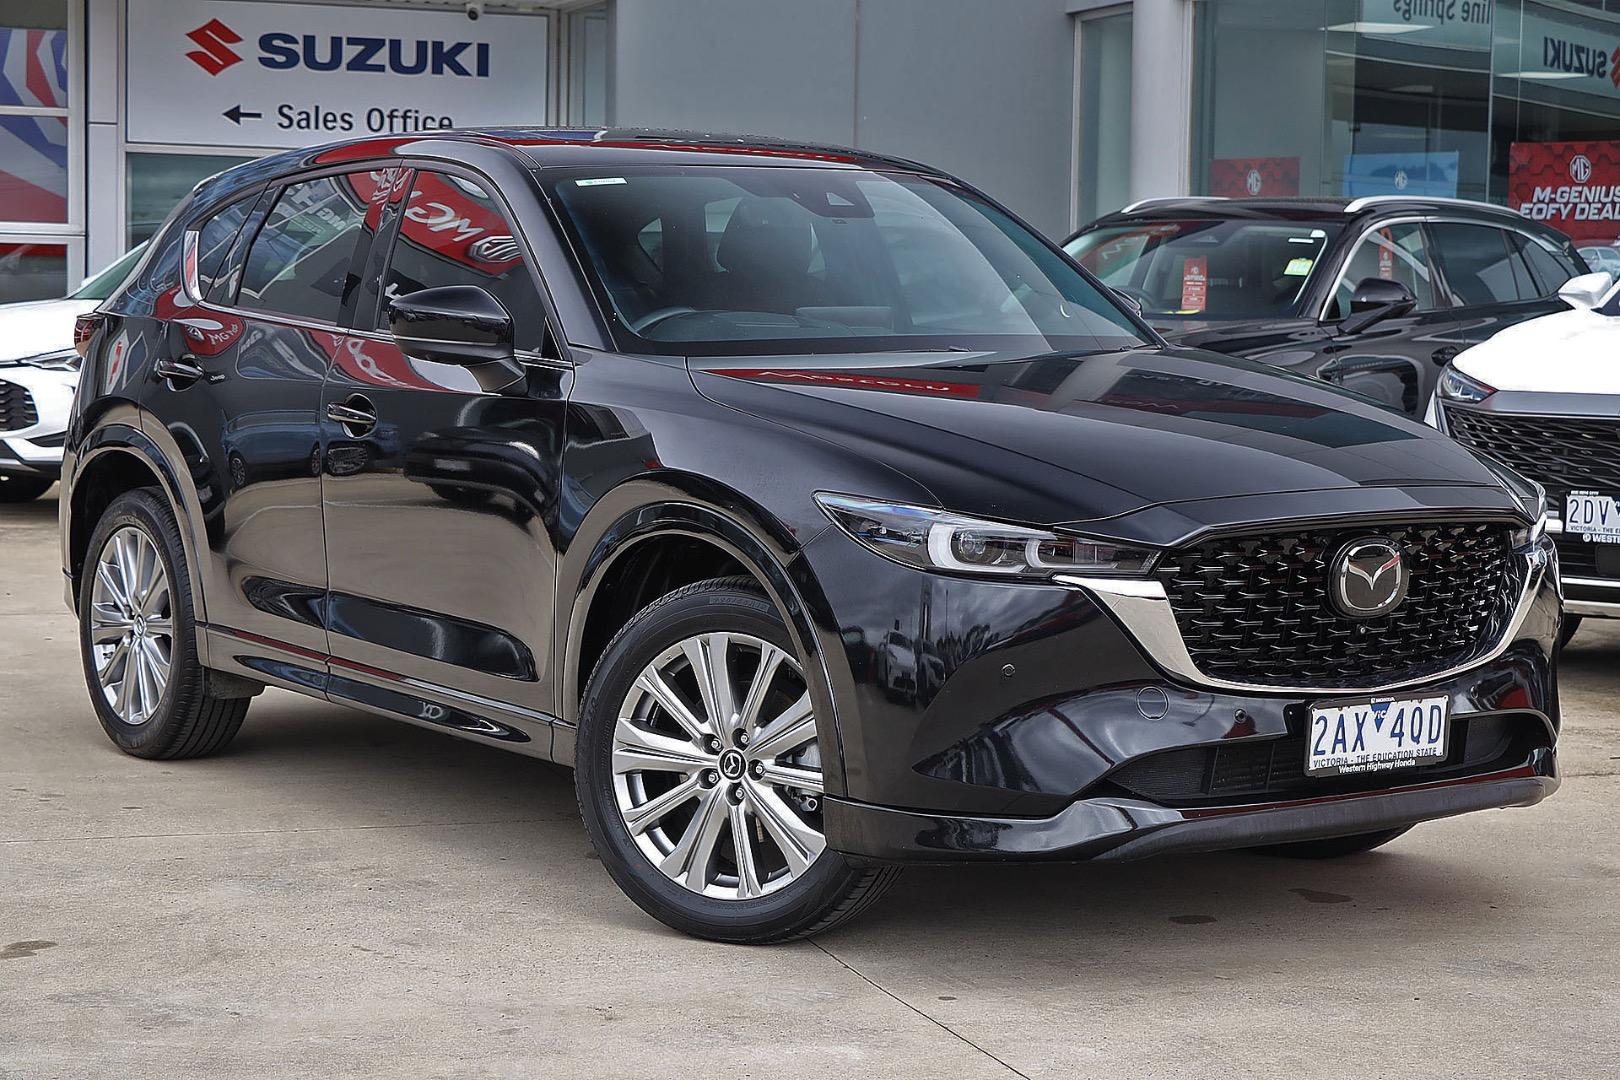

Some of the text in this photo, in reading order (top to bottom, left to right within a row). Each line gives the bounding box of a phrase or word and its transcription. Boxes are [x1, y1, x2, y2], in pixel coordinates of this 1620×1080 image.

[258, 32, 490, 77] SUZUKI
[277, 103, 453, 133] Sales Office
[1571, 156, 1591, 182] MG
[1520, 203, 1573, 220] EOFY
[1569, 499, 1609, 525] 2DV
[1313, 711, 1368, 756] 2AX
[1313, 757, 1349, 768] VICTORIA
[1356, 754, 1371, 764] THE
[1372, 750, 1414, 762] EDUCATION
[1416, 748, 1436, 757] STATE
[1338, 758, 1416, 774] Western Highway Honda
